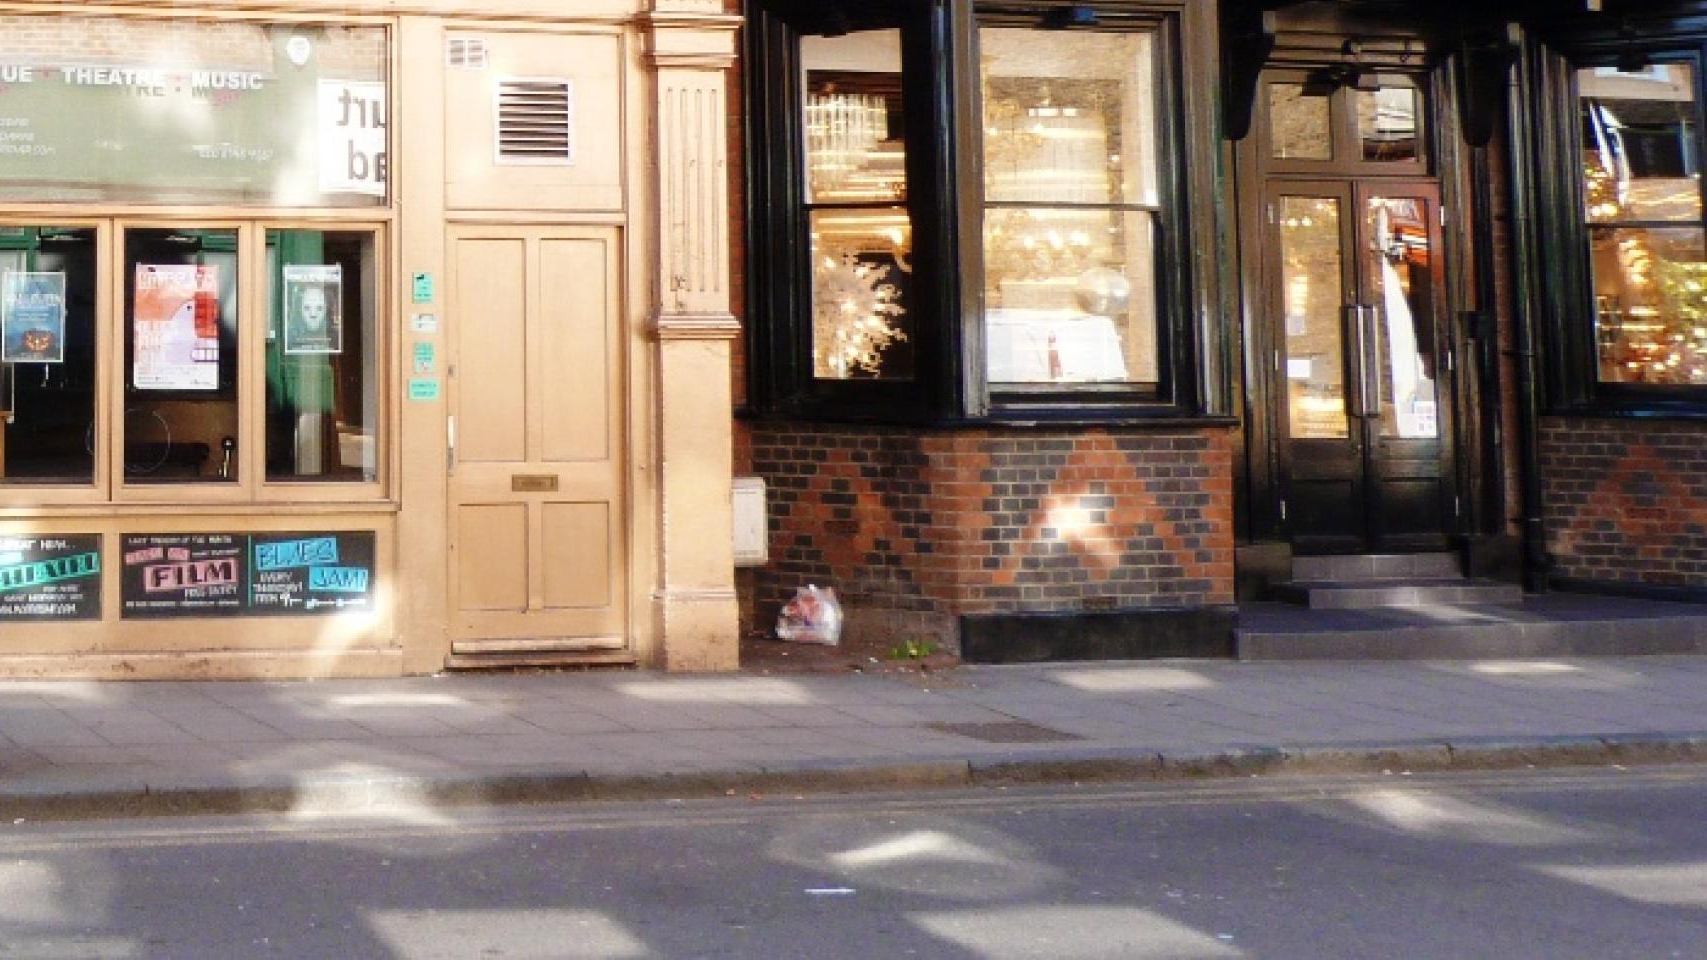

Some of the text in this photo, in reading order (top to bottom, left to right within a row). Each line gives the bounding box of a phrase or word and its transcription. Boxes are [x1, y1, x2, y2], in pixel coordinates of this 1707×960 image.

[60, 67, 167, 87] THEATRE
[192, 71, 263, 91] MUSIC
[152, 561, 232, 587] FILM
